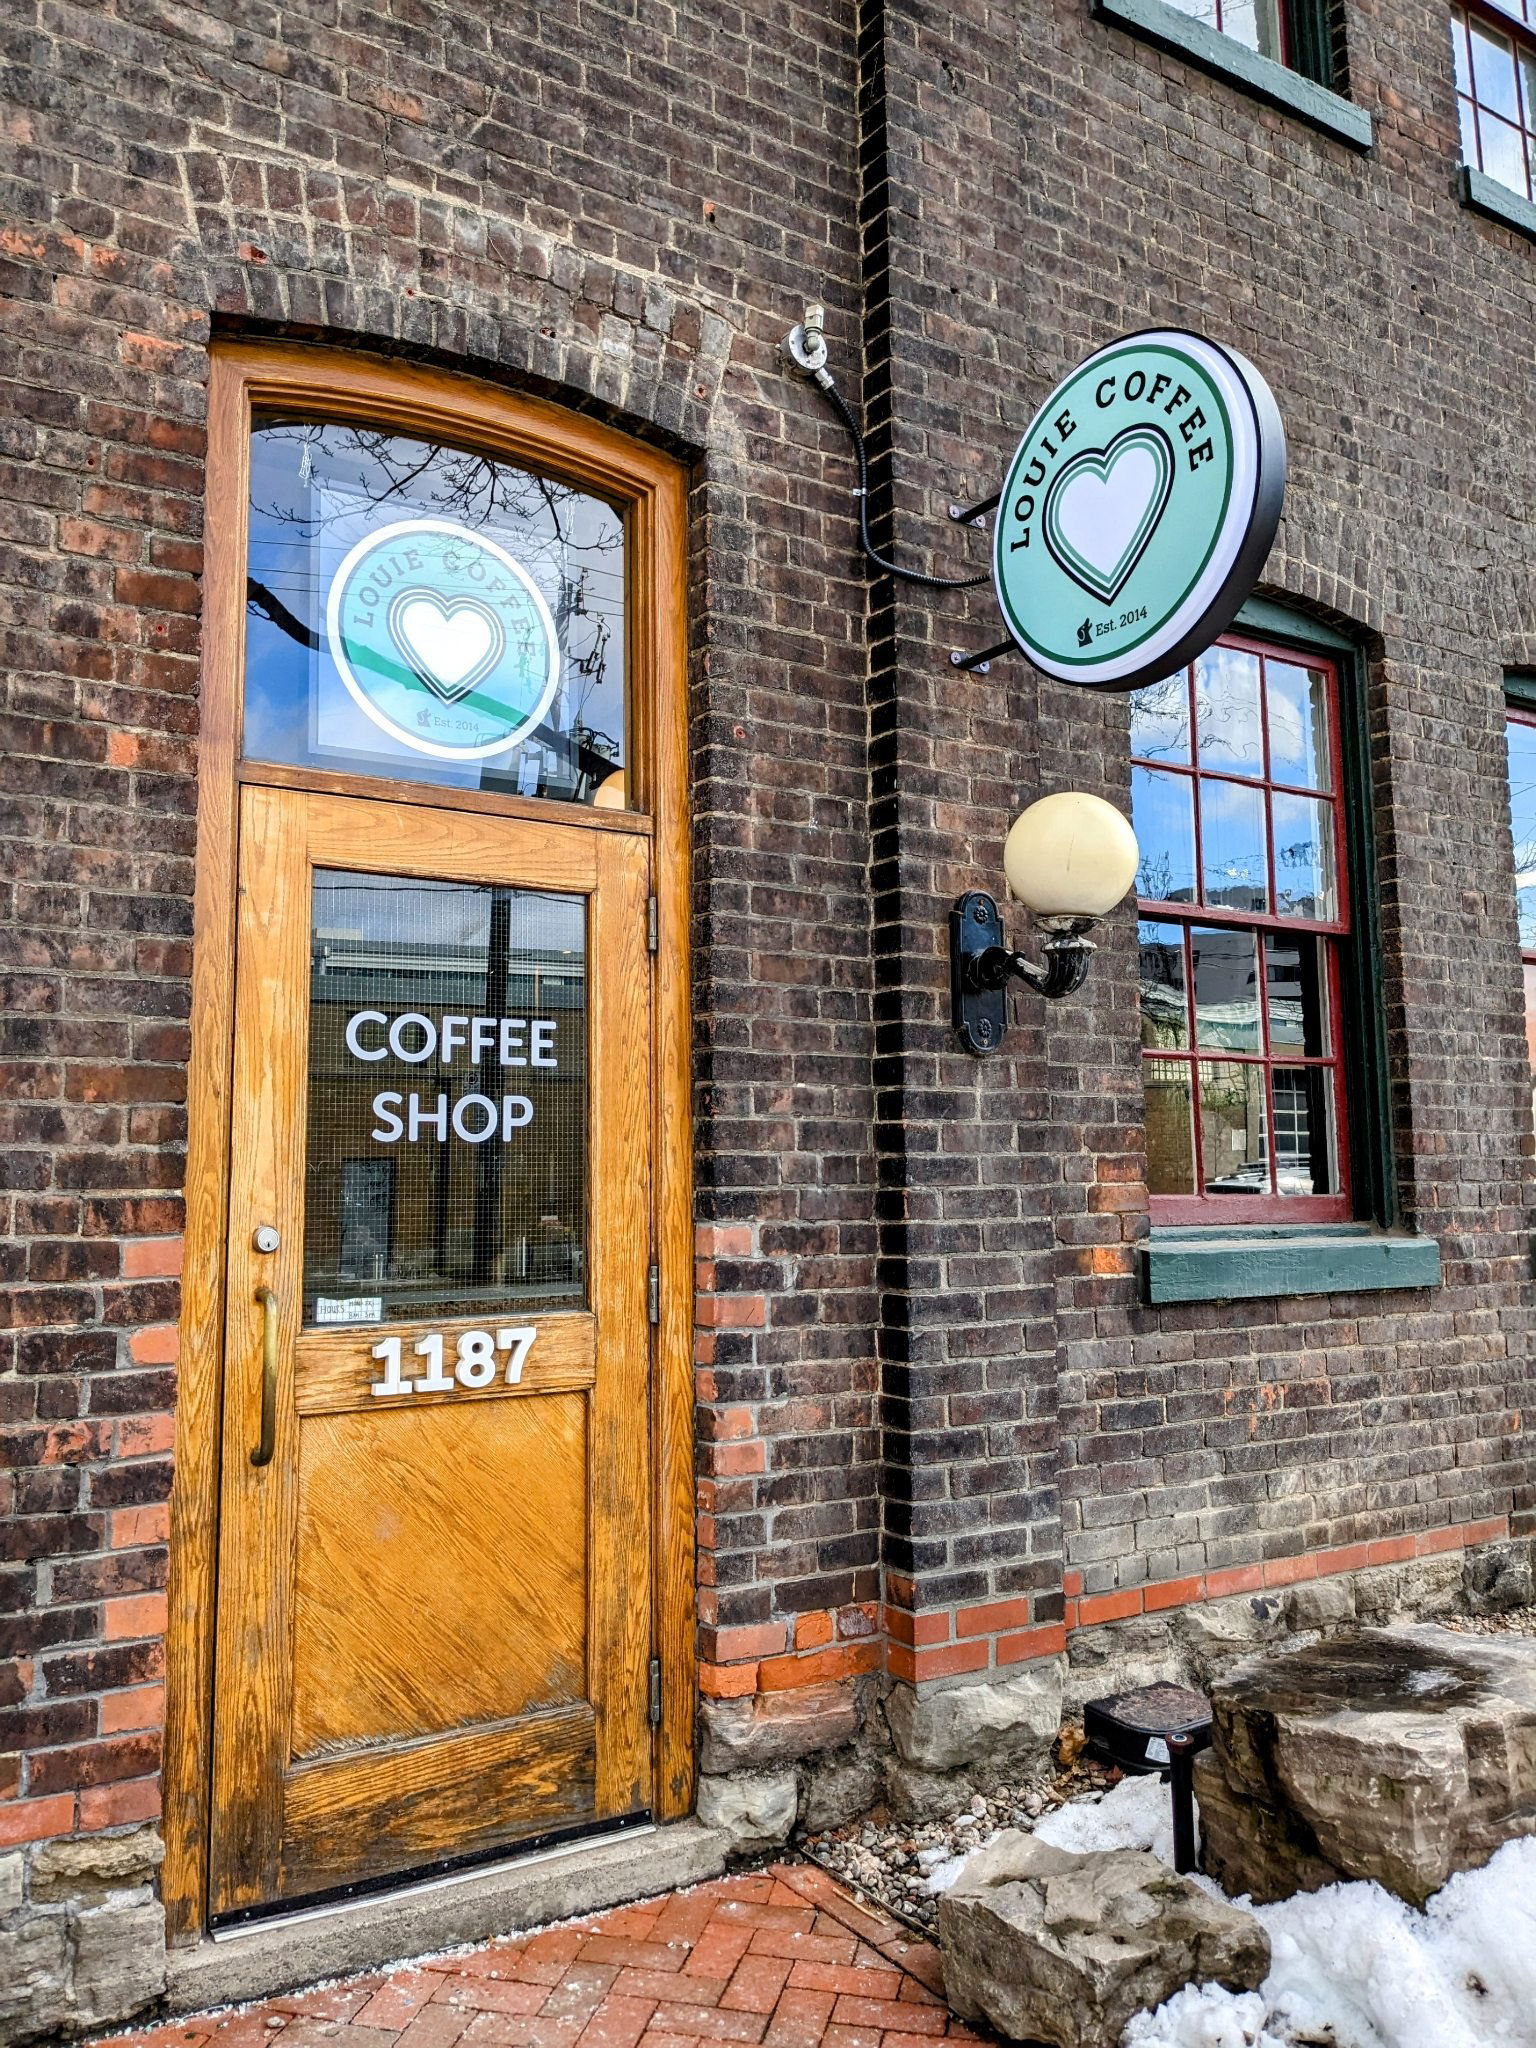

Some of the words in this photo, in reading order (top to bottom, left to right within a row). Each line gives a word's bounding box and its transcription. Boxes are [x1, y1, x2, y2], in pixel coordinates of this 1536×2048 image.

[1010, 409, 1078, 553] LOUIE
[1095, 370, 1214, 472] COFFEE
[353, 548, 424, 629] LOUIE
[442, 550, 536, 658] COFFEE
[1095, 619, 1117, 637] Est.
[1119, 606, 1148, 627] 2014
[455, 718, 480, 732] 2014
[346, 1010, 558, 1067] COFFEE
[372, 1091, 534, 1143] SHOP
[371, 1326, 538, 1397] 1187
